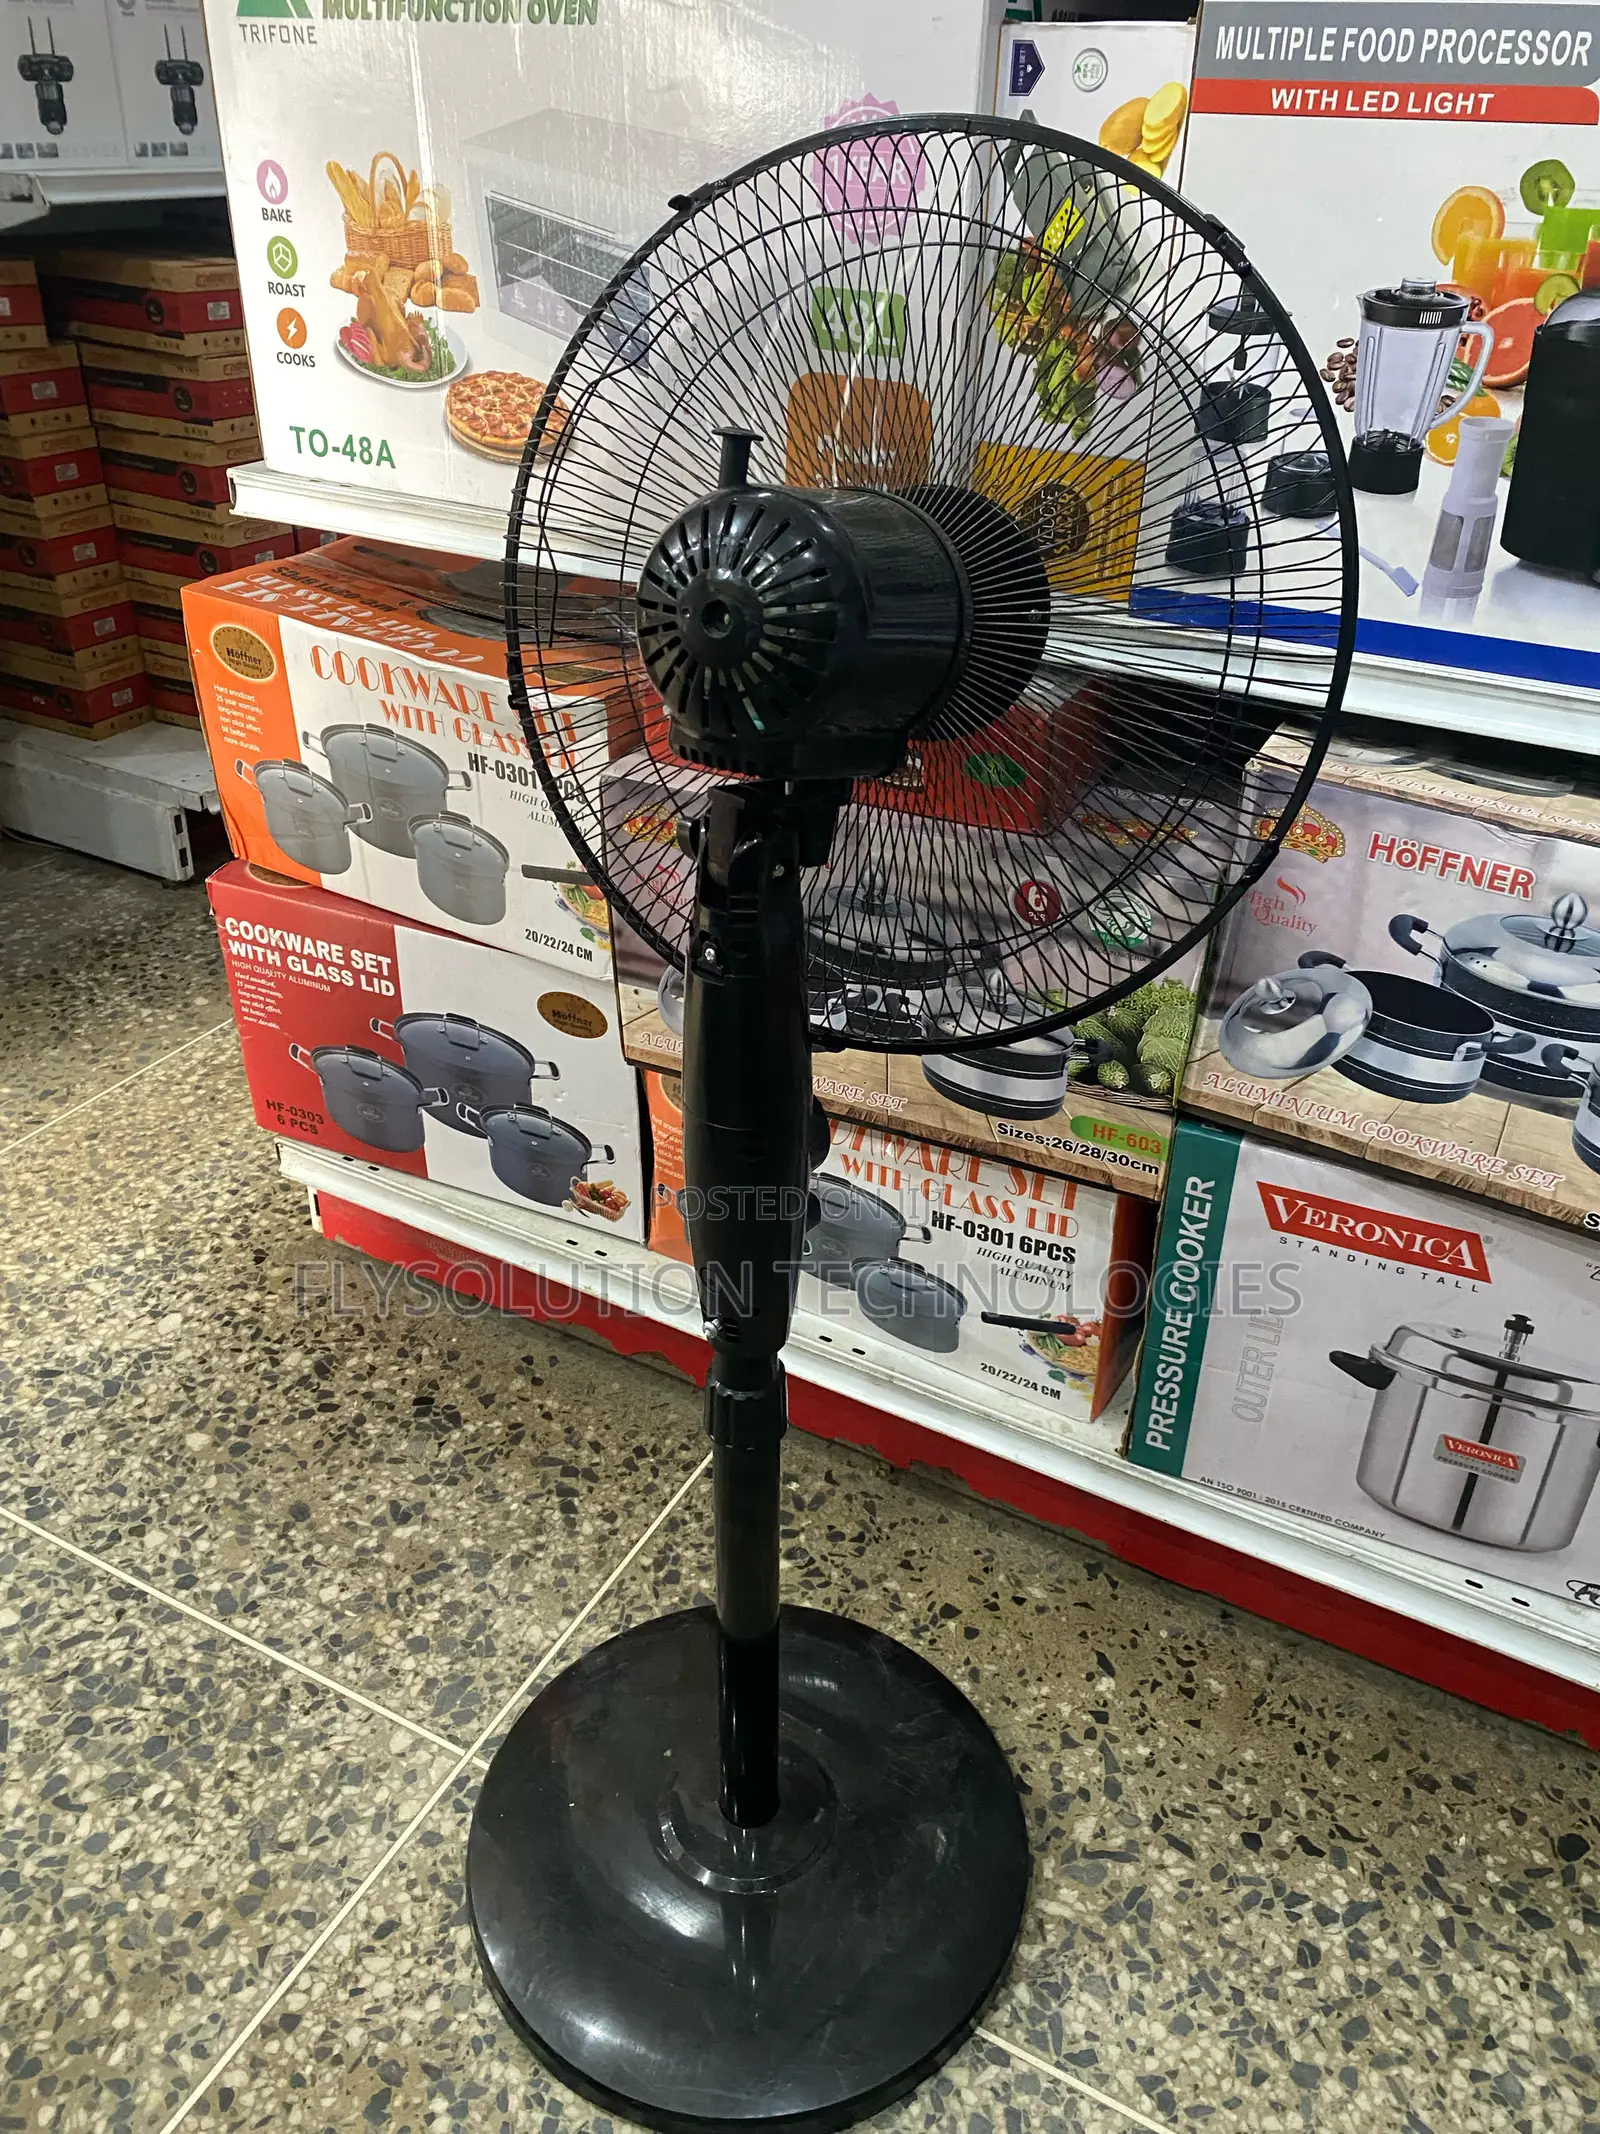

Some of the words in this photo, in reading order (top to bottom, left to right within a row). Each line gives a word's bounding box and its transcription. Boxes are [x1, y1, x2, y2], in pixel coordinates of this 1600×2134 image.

[322, 0, 519, 24] MULTIFUNCTION
[527, 0, 600, 26] OVEN
[238, 23, 318, 45] TRIFONE
[1215, 25, 1338, 62] MULTIPLE
[1341, 27, 1415, 63] FOOD
[1419, 28, 1593, 67] PROCESSOR
[1271, 87, 1339, 112] WITH
[1345, 89, 1408, 113] LED
[1407, 90, 1495, 116] LIGHT
[847, 155, 906, 185] YEAR
[261, 207, 293, 223] BAKE
[267, 281, 306, 298] ROAST
[276, 351, 316, 368] COOKS
[289, 425, 396, 469] TO-48A
[310, 644, 506, 726] COOKWARE
[378, 699, 446, 737] WITH
[468, 751, 538, 790] HF-0301
[510, 790, 538, 807] HIGH
[1028, 886, 1048, 912] 6
[1244, 890, 1284, 911] High
[1254, 906, 1317, 937] Quality
[225, 917, 345, 966] COOKWARE
[350, 949, 392, 977] SET
[525, 928, 574, 956] 20/22/24
[576, 946, 593, 962] CM
[227, 939, 281, 967] WITH
[286, 955, 354, 987] GLASS
[359, 974, 395, 997] LID
[231, 960, 252, 971] HIGH
[253, 965, 287, 980] QUALITY
[288, 975, 331, 993] ALUMINUM
[265, 1099, 324, 1125] HF-0303
[868, 1093, 907, 1112] SET
[277, 1114, 286, 1125] 6
[290, 1118, 318, 1135] PCS
[1092, 1123, 1162, 1155] HF-603
[1203, 1073, 1360, 1130] ALUMINIUM
[1360, 1121, 1506, 1175] COOKWARE
[1506, 1166, 1563, 1191] SET
[840, 1153, 912, 1191] WITH
[920, 1178, 1015, 1224] GLASS
[1026, 1207, 1080, 1239] LID
[1004, 1166, 1079, 1211] SET
[932, 1211, 1014, 1250] HF-0301
[1019, 1236, 1076, 1264] 6PCS
[1269, 1194, 1479, 1272] VERONICA
[977, 1247, 1012, 1264] HIGH
[1015, 1258, 1074, 1279] QUALITY
[996, 1266, 1072, 1292] ALUMINUM
[1279, 1236, 1405, 1276] STANDING
[1421, 1272, 1480, 1293] TALL
[1145, 1307, 1193, 1451] PRESSURE
[1169, 1176, 1216, 1303] COOKER
[1247, 1308, 1284, 1347] LID
[980, 1362, 1038, 1392] 20/22/24
[1041, 1385, 1061, 1400] CM
[1231, 1349, 1278, 1424] OUTER
[1200, 1476, 1214, 1486] AN
[1236, 1487, 1257, 1499] 9001
[1264, 1495, 1287, 1509] 2015
[1288, 1503, 1333, 1522] CERTIFIED
[1334, 1518, 1386, 1539] COMPANY
